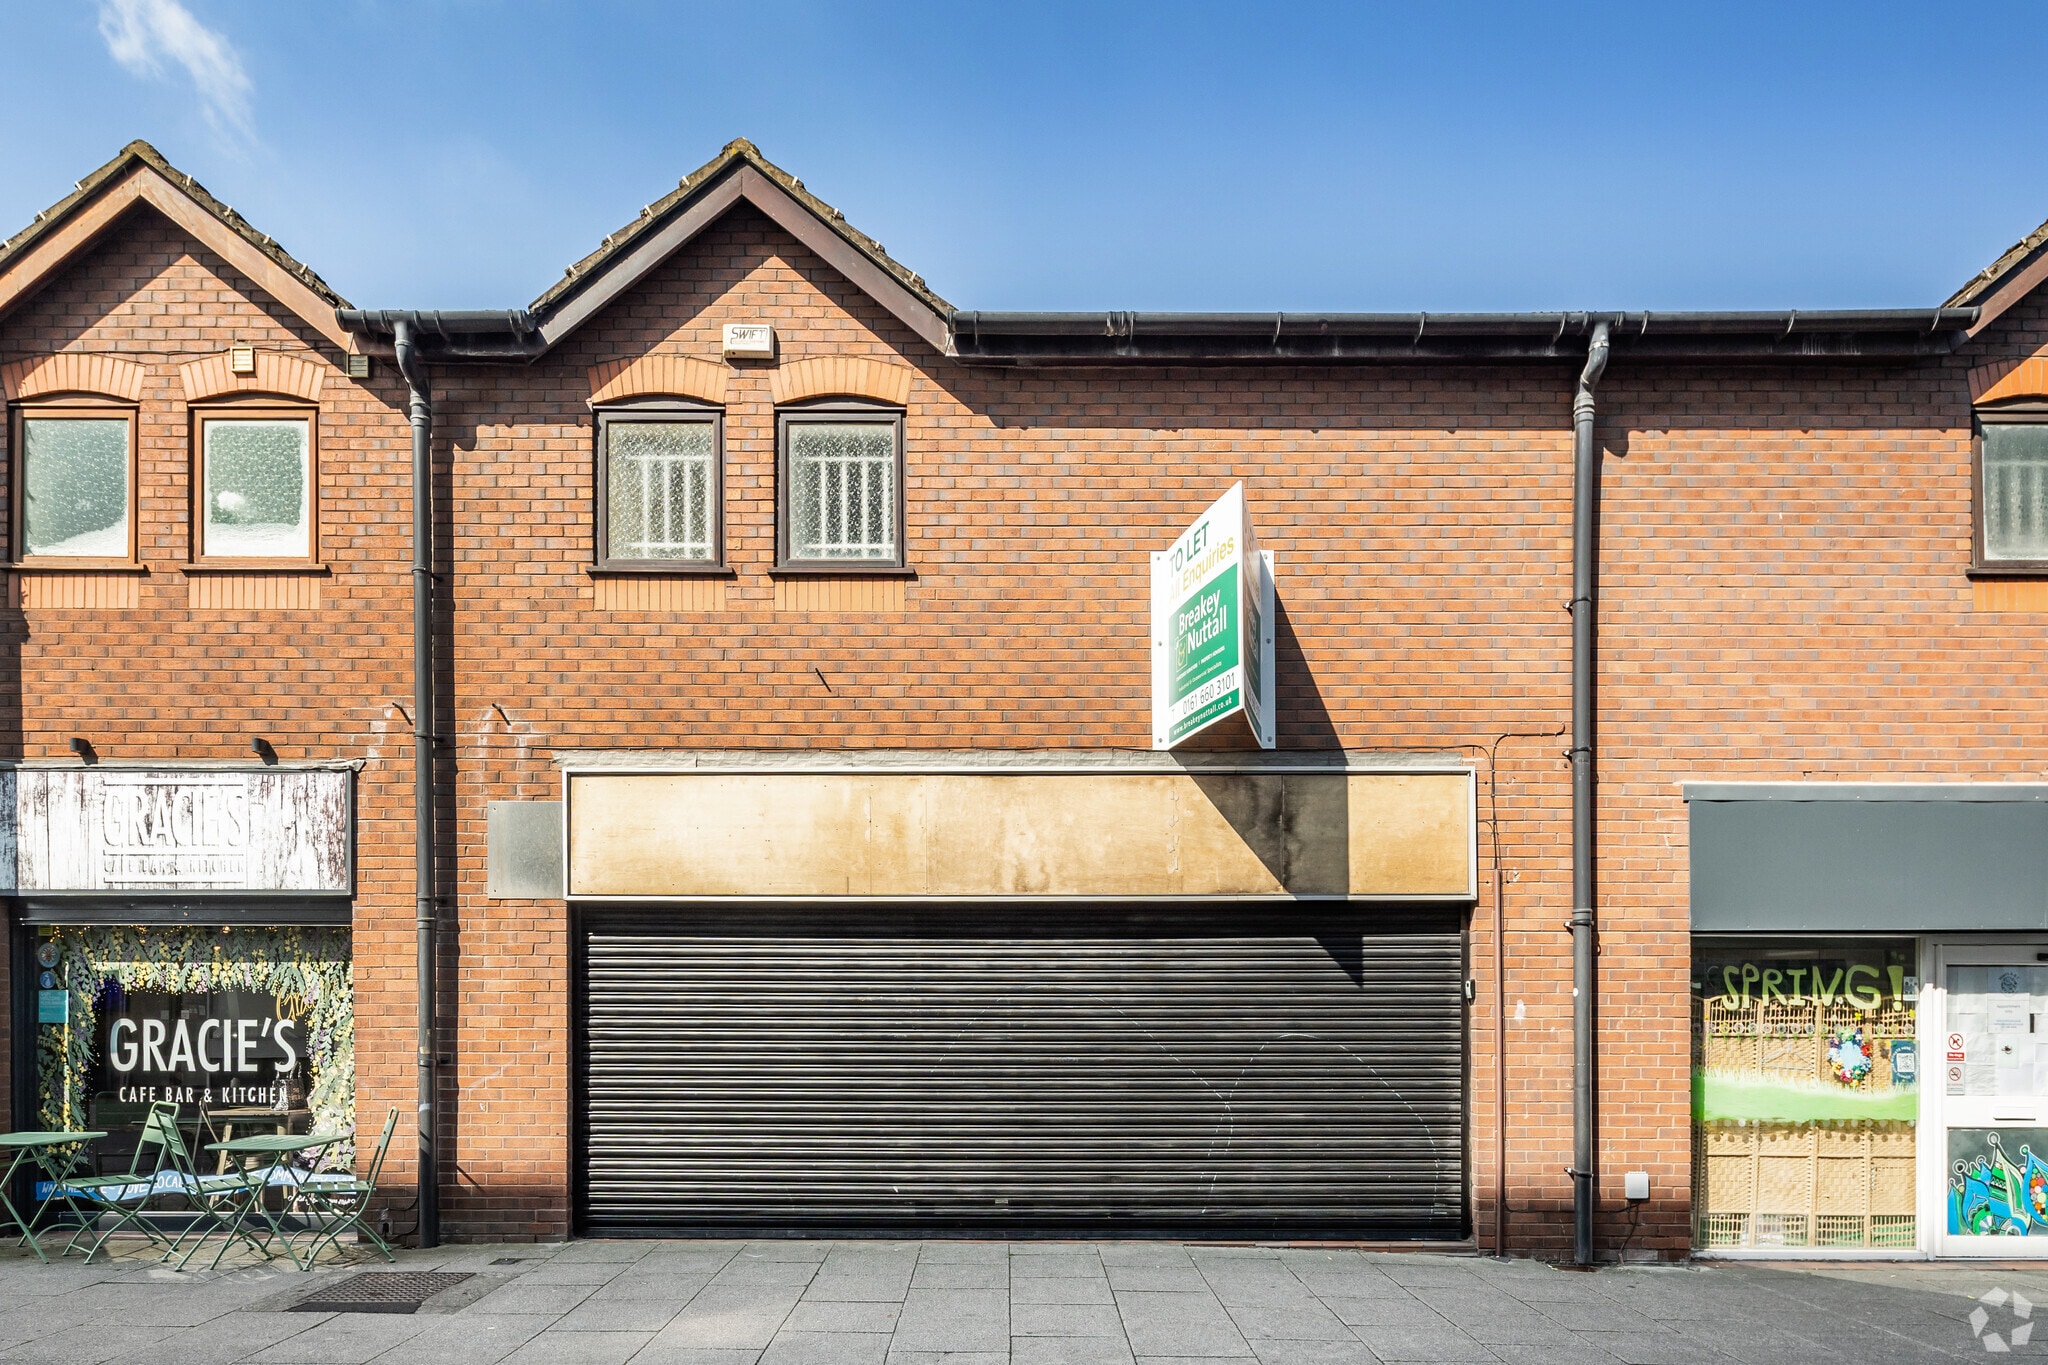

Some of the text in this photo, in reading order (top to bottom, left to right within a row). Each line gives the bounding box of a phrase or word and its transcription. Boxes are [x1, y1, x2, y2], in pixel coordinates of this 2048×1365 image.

[731, 326, 767, 344] SWIFT
[1169, 547, 1183, 578] TO
[1186, 520, 1210, 562] LET
[1183, 536, 1234, 592] Enquiries
[1179, 588, 1221, 636] Breakey
[1187, 604, 1227, 654] Nuttall
[1173, 696, 1233, 735] www.breakeynuttall.co.uk
[1182, 693, 1198, 715] 0161
[1200, 684, 1214, 705] 660
[1217, 672, 1235, 695] 3101
[1721, 962, 1904, 1012] SPRING!
[110, 1017, 296, 1073] GRACIE'S
[119, 1086, 288, 1103] CAFE BAR & KITCHEN
